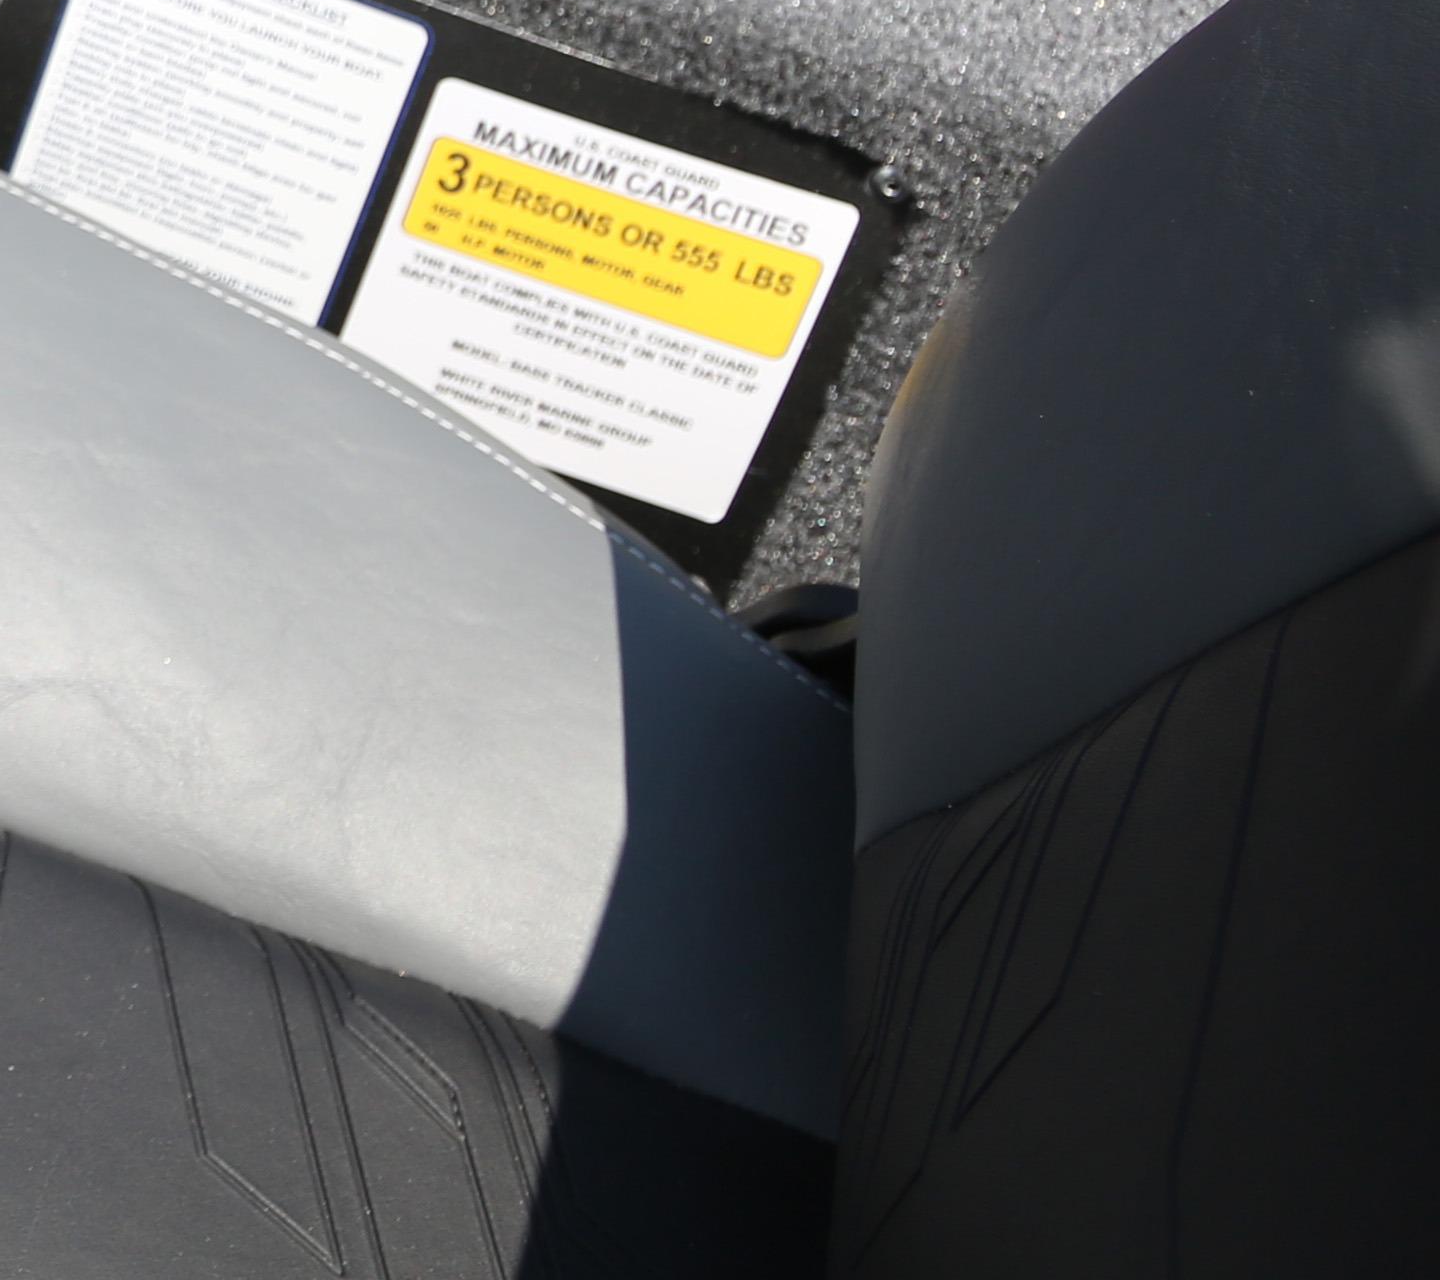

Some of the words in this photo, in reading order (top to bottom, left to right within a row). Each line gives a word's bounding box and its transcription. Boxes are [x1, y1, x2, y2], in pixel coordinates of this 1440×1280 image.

[436, 153, 473, 194] 3
[469, 173, 617, 239] PERSONS
[616, 221, 668, 256] OR
[669, 238, 725, 274] 555
[731, 259, 798, 298] LBS
[468, 120, 621, 186] MAXIMUM
[622, 170, 811, 247] CAPACITIES
